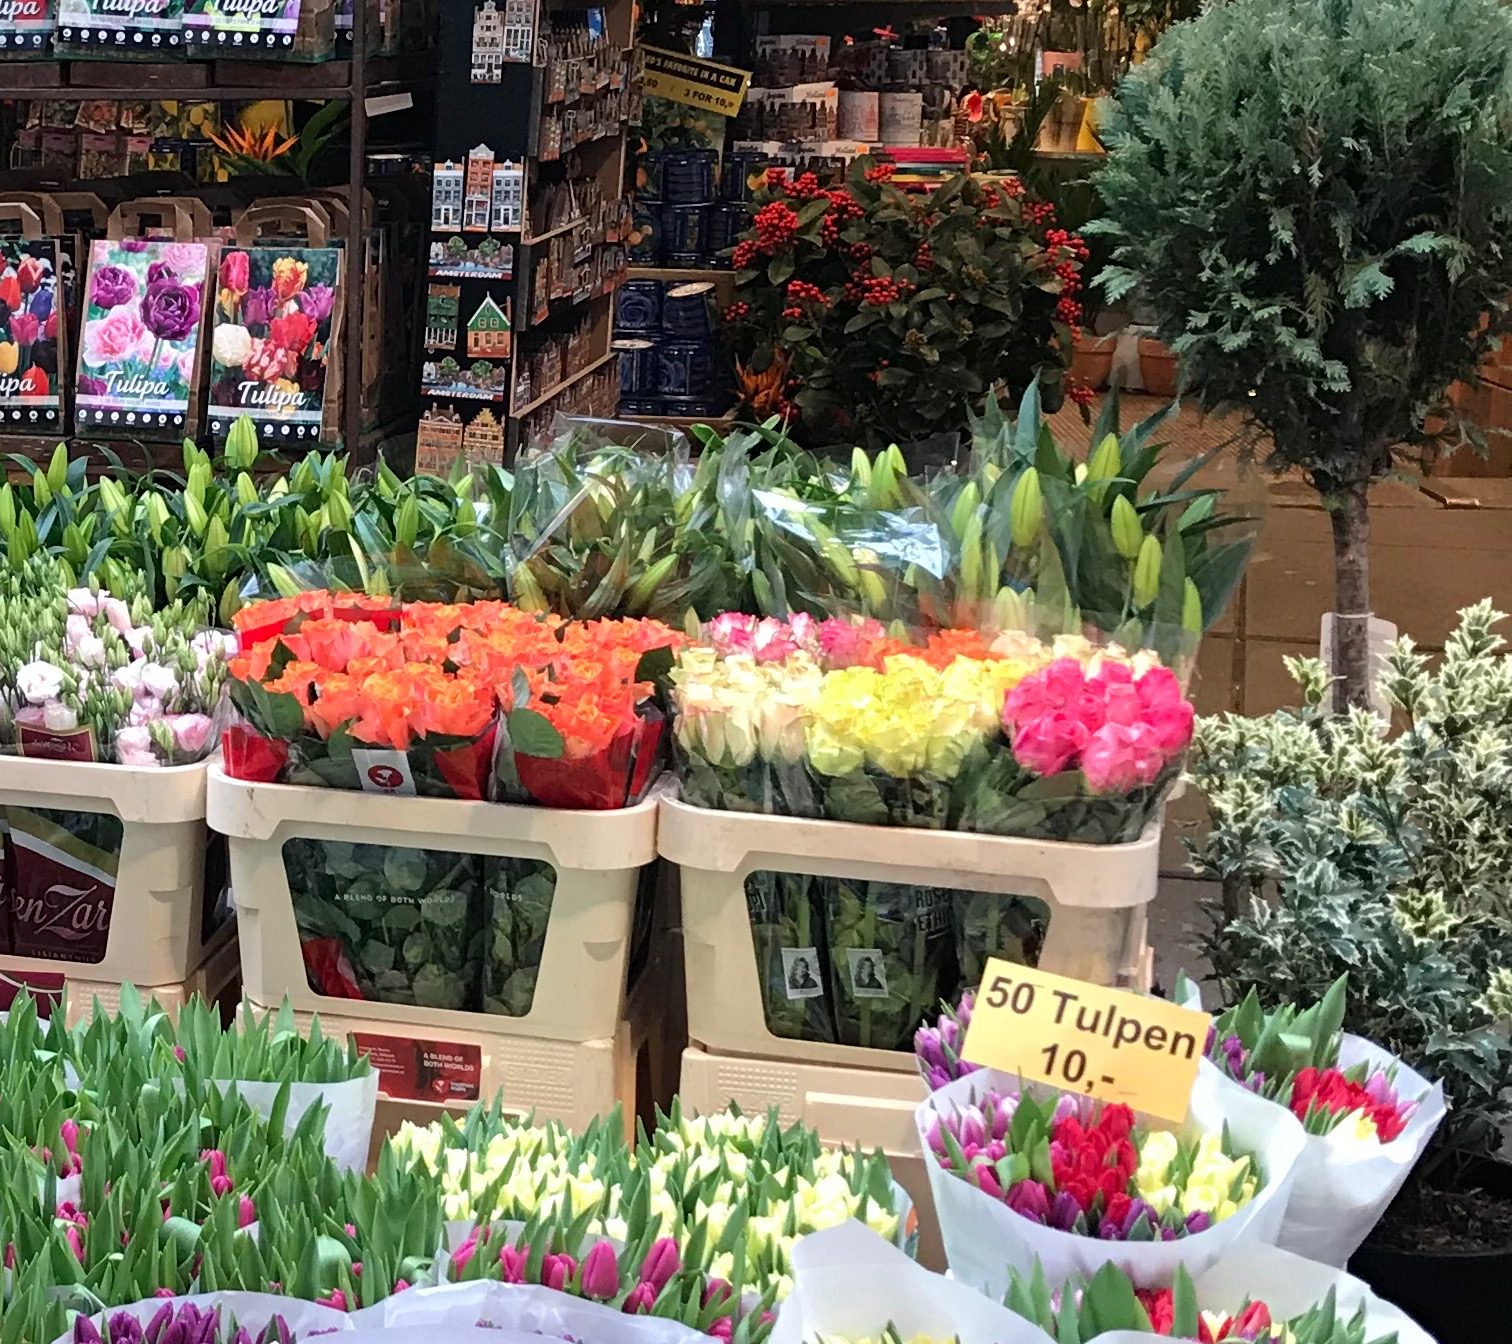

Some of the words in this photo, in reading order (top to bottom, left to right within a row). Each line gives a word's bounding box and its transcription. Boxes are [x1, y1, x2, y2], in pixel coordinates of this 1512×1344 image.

[435, 269, 503, 279] AMSTERDAM
[104, 370, 170, 399] Tulipa
[238, 381, 307, 410] Tulipa
[427, 389, 494, 400] AMSTERDAM
[10, 884, 110, 941] senZar
[985, 975, 1036, 1015] 50
[1051, 990, 1197, 1061] Tulpen
[1040, 1043, 1116, 1095] 10,-
